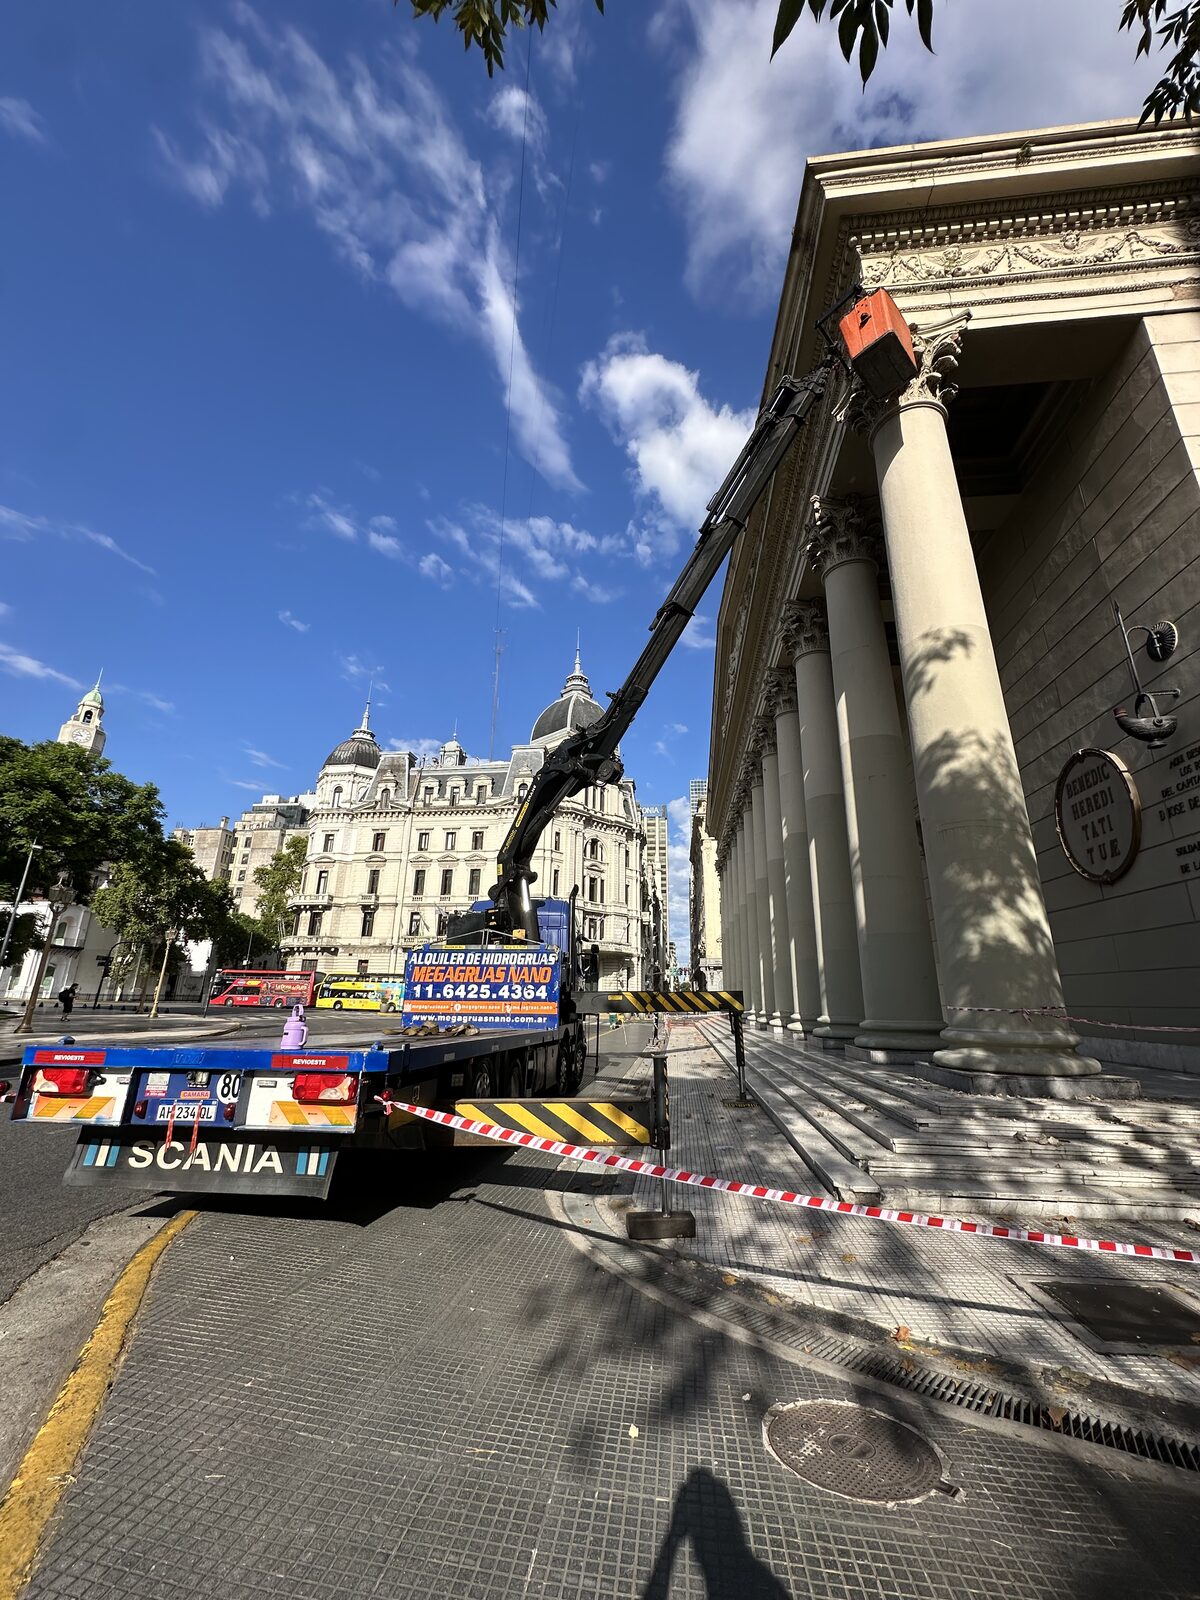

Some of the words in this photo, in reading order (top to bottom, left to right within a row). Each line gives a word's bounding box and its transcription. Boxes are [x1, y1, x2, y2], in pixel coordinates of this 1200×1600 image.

[1180, 764, 1192, 777] LOS
[1067, 763, 1110, 798] BENEDIC
[1071, 786, 1115, 820] HEREDI
[1081, 814, 1114, 841] TATI
[409, 952, 464, 966] ALQUILER
[465, 953, 481, 965] DE
[481, 952, 556, 966] HIDROGRUAS
[412, 966, 507, 983] MEGAGRUAS
[507, 966, 552, 983] NANO
[414, 984, 547, 999] 11.6425.4364
[412, 1013, 547, 1024] www.megagruasnano.com.ar
[292, 1058, 327, 1066] REVIOESTE
[221, 1074, 240, 1098] 80
[176, 1107, 196, 1118] 234
[200, 1107, 213, 1118] QL
[128, 1140, 283, 1173] SCANIA
